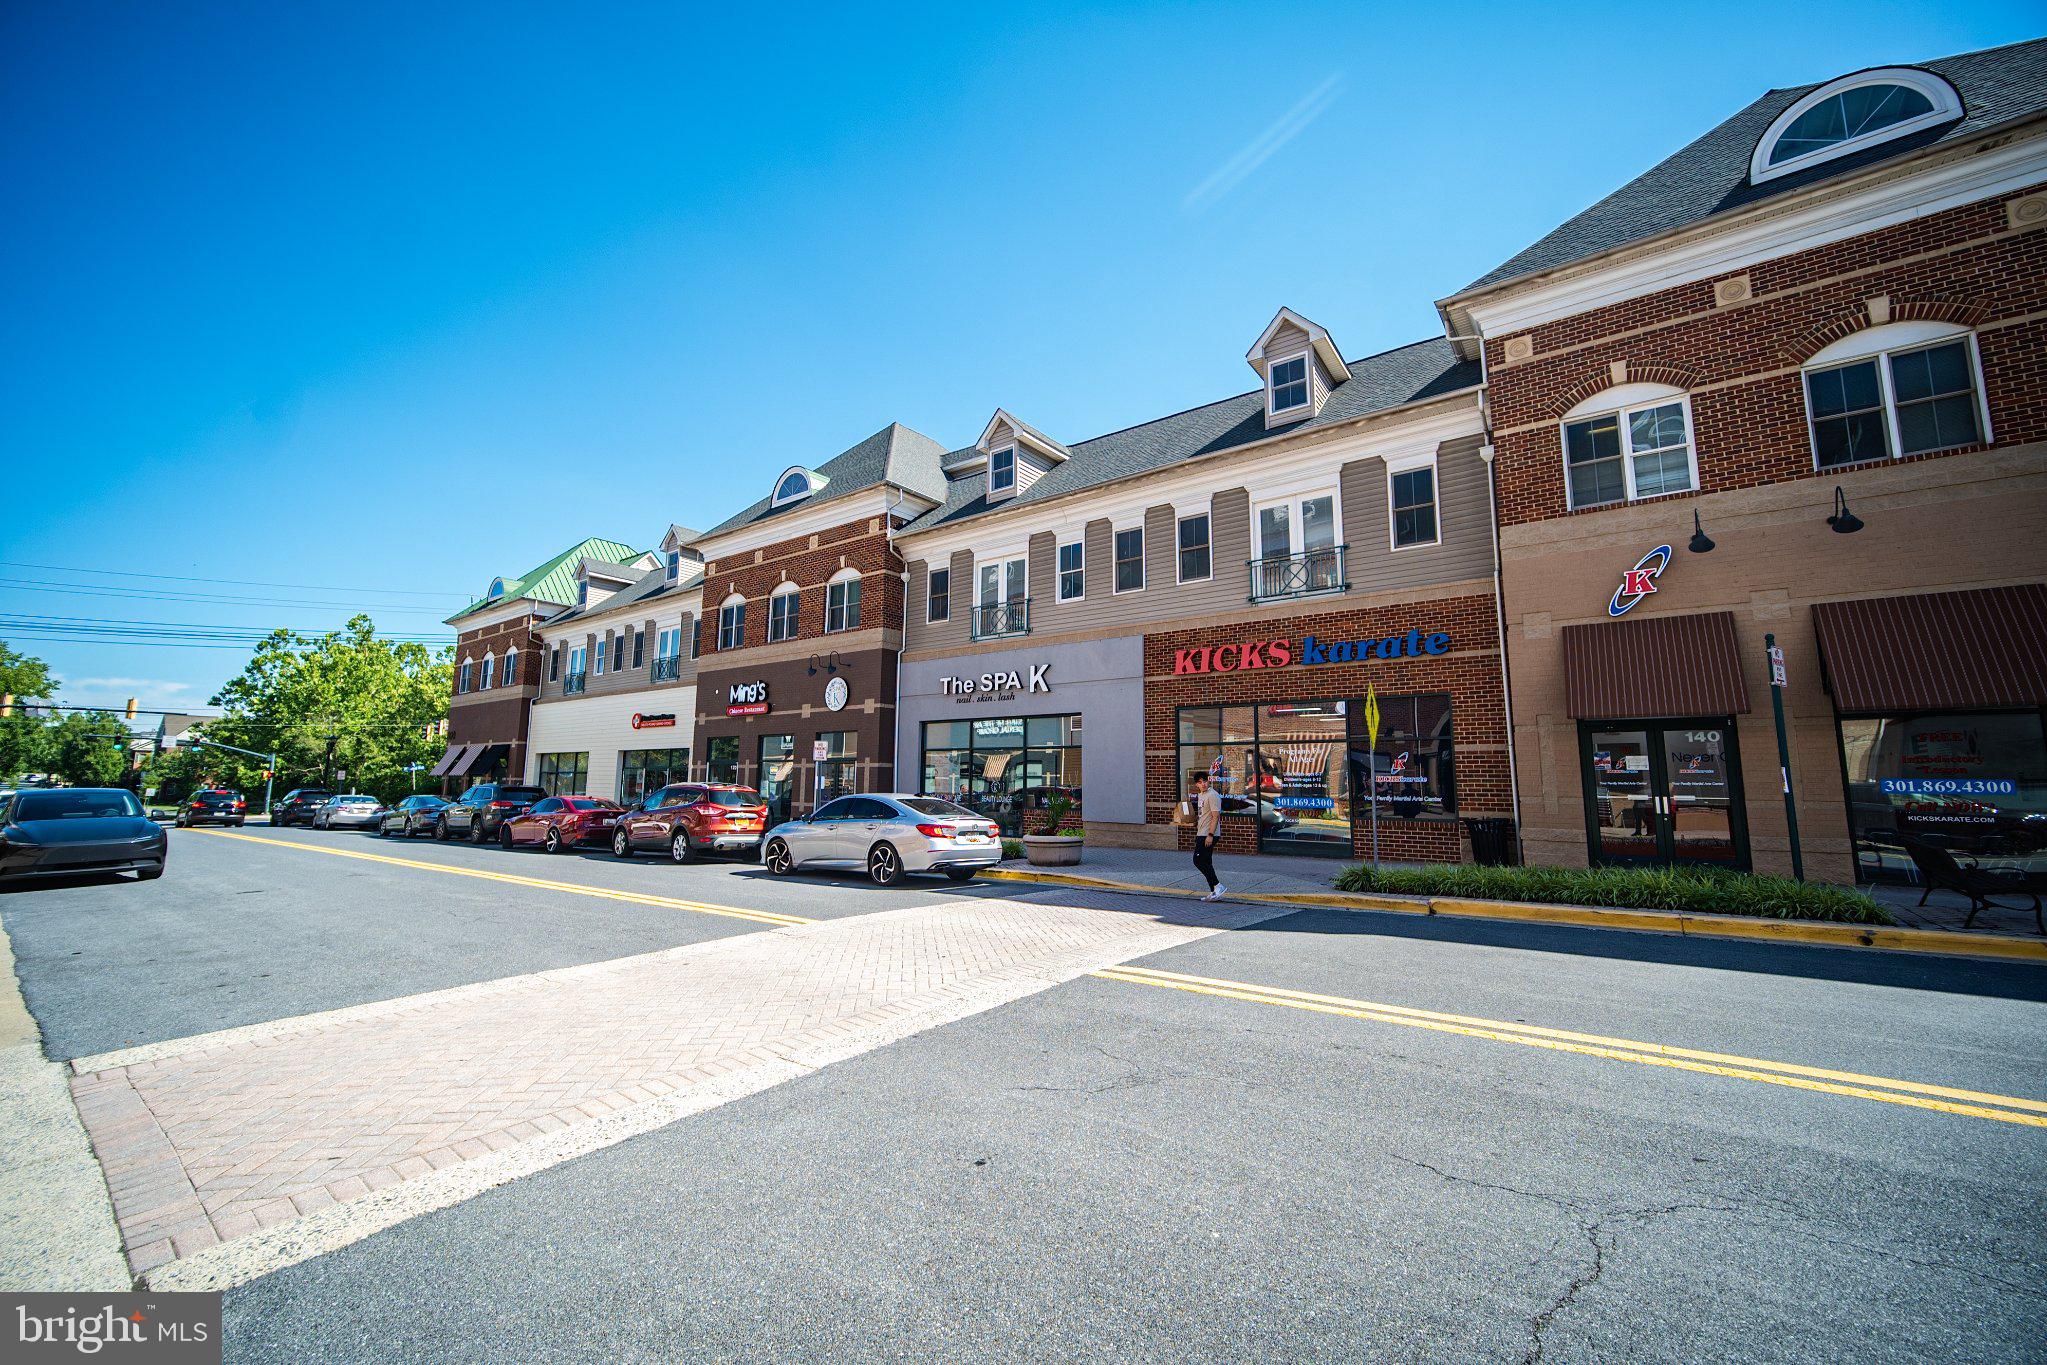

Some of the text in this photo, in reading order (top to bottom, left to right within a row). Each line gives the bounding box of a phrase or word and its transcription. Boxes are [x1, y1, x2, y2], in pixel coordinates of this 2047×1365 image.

[1172, 628, 1450, 675] KICKS karate
[940, 664, 1051, 695] The SPA K
[729, 681, 768, 704] Ming's
[977, 693, 993, 702] skin
[998, 692, 1015, 701] lash
[1685, 731, 1720, 742] 140
[1884, 780, 2013, 793] 301.869.4300
[1277, 798, 1332, 807] 301.869.4300
[1907, 815, 1995, 823] KICKSKARATE.COM
